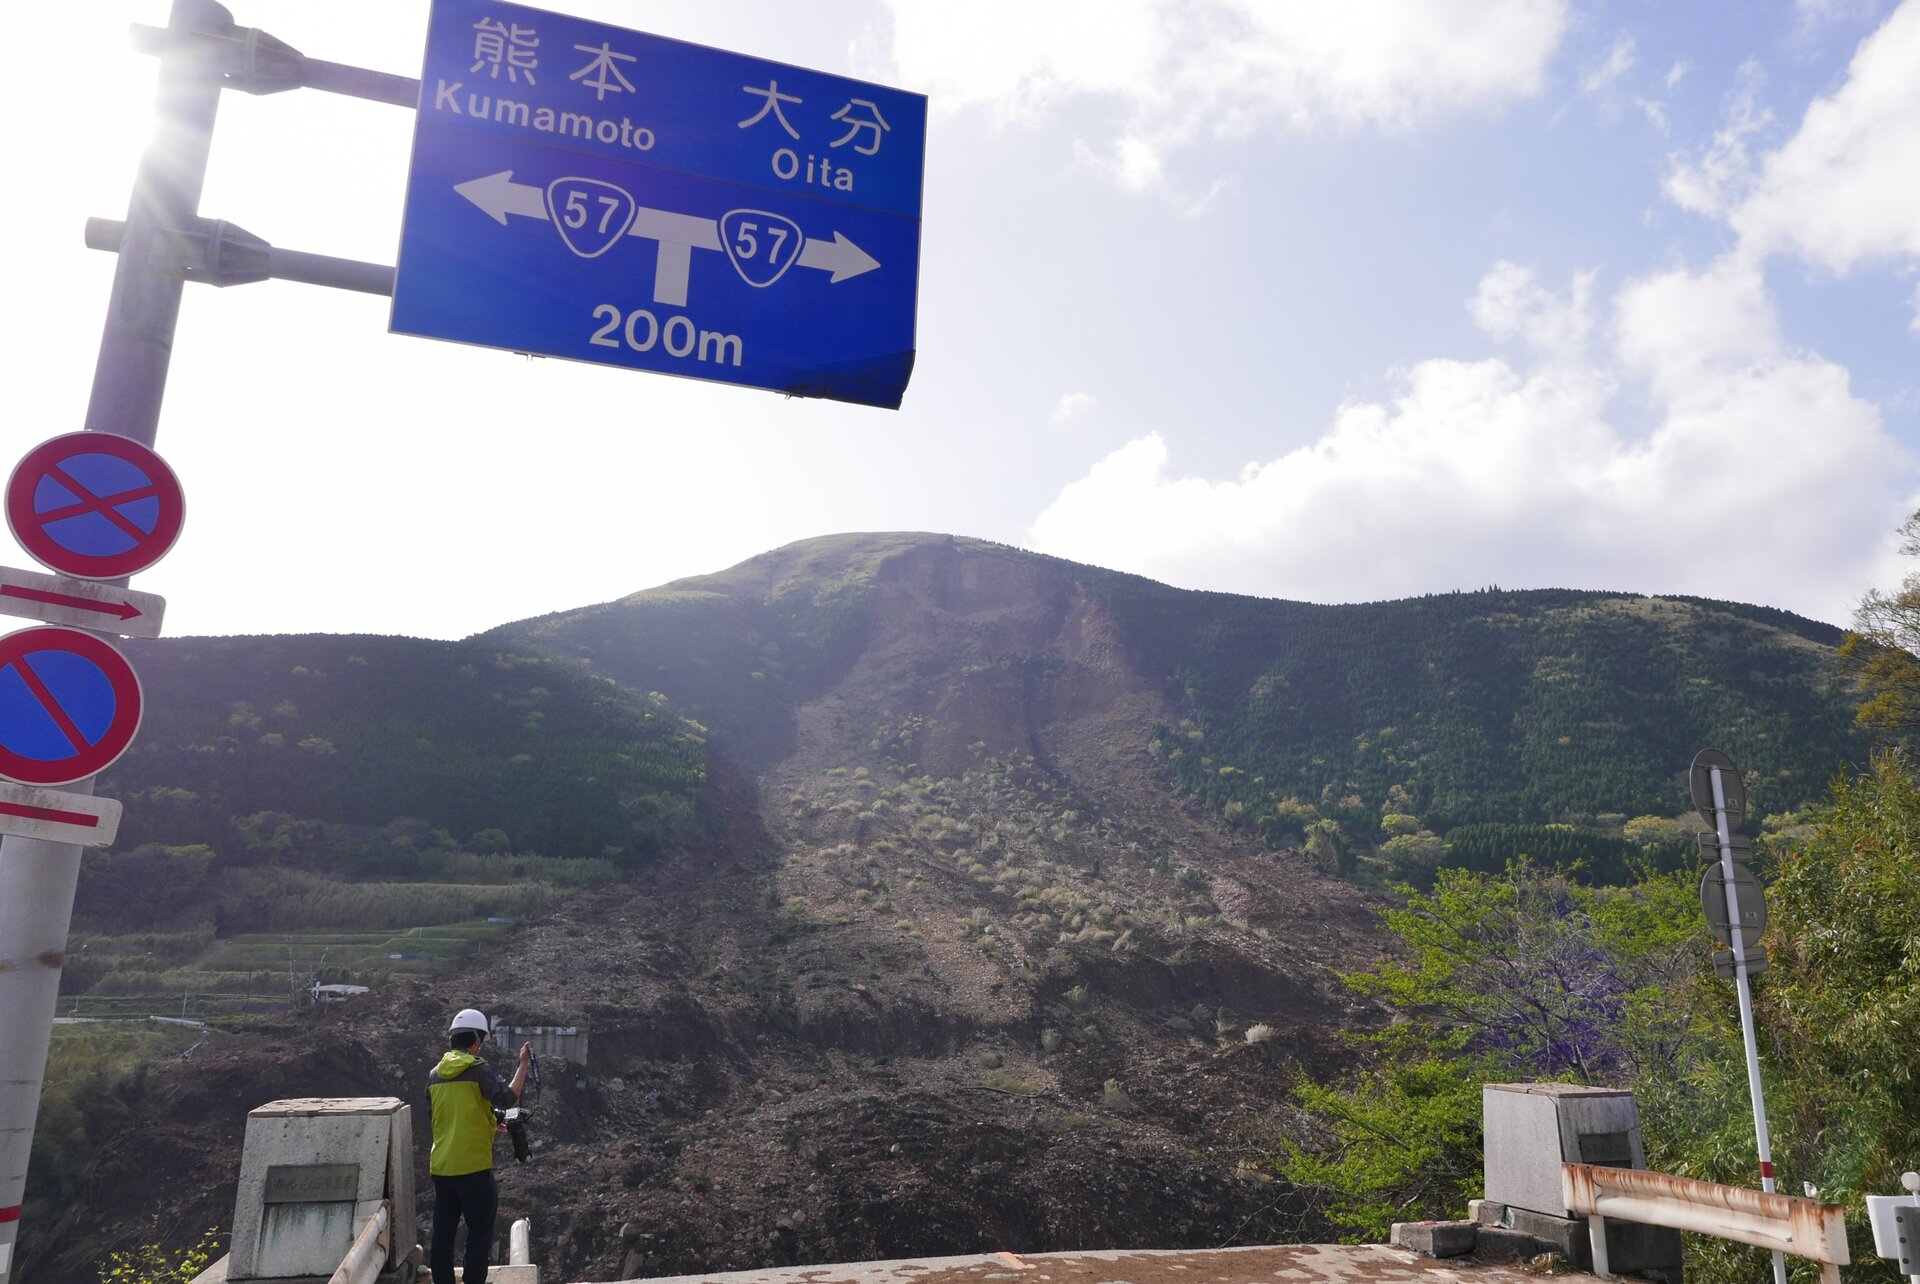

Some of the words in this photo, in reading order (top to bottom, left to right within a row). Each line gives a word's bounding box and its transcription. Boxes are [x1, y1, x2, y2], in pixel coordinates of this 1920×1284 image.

[471, 16, 638, 100] 熊本
[434, 79, 656, 151] Kumamoto
[738, 80, 891, 156] 大分
[771, 147, 854, 191] Oita
[562, 190, 620, 234] 57
[735, 222, 788, 264] 57
[589, 303, 744, 367] 200m
